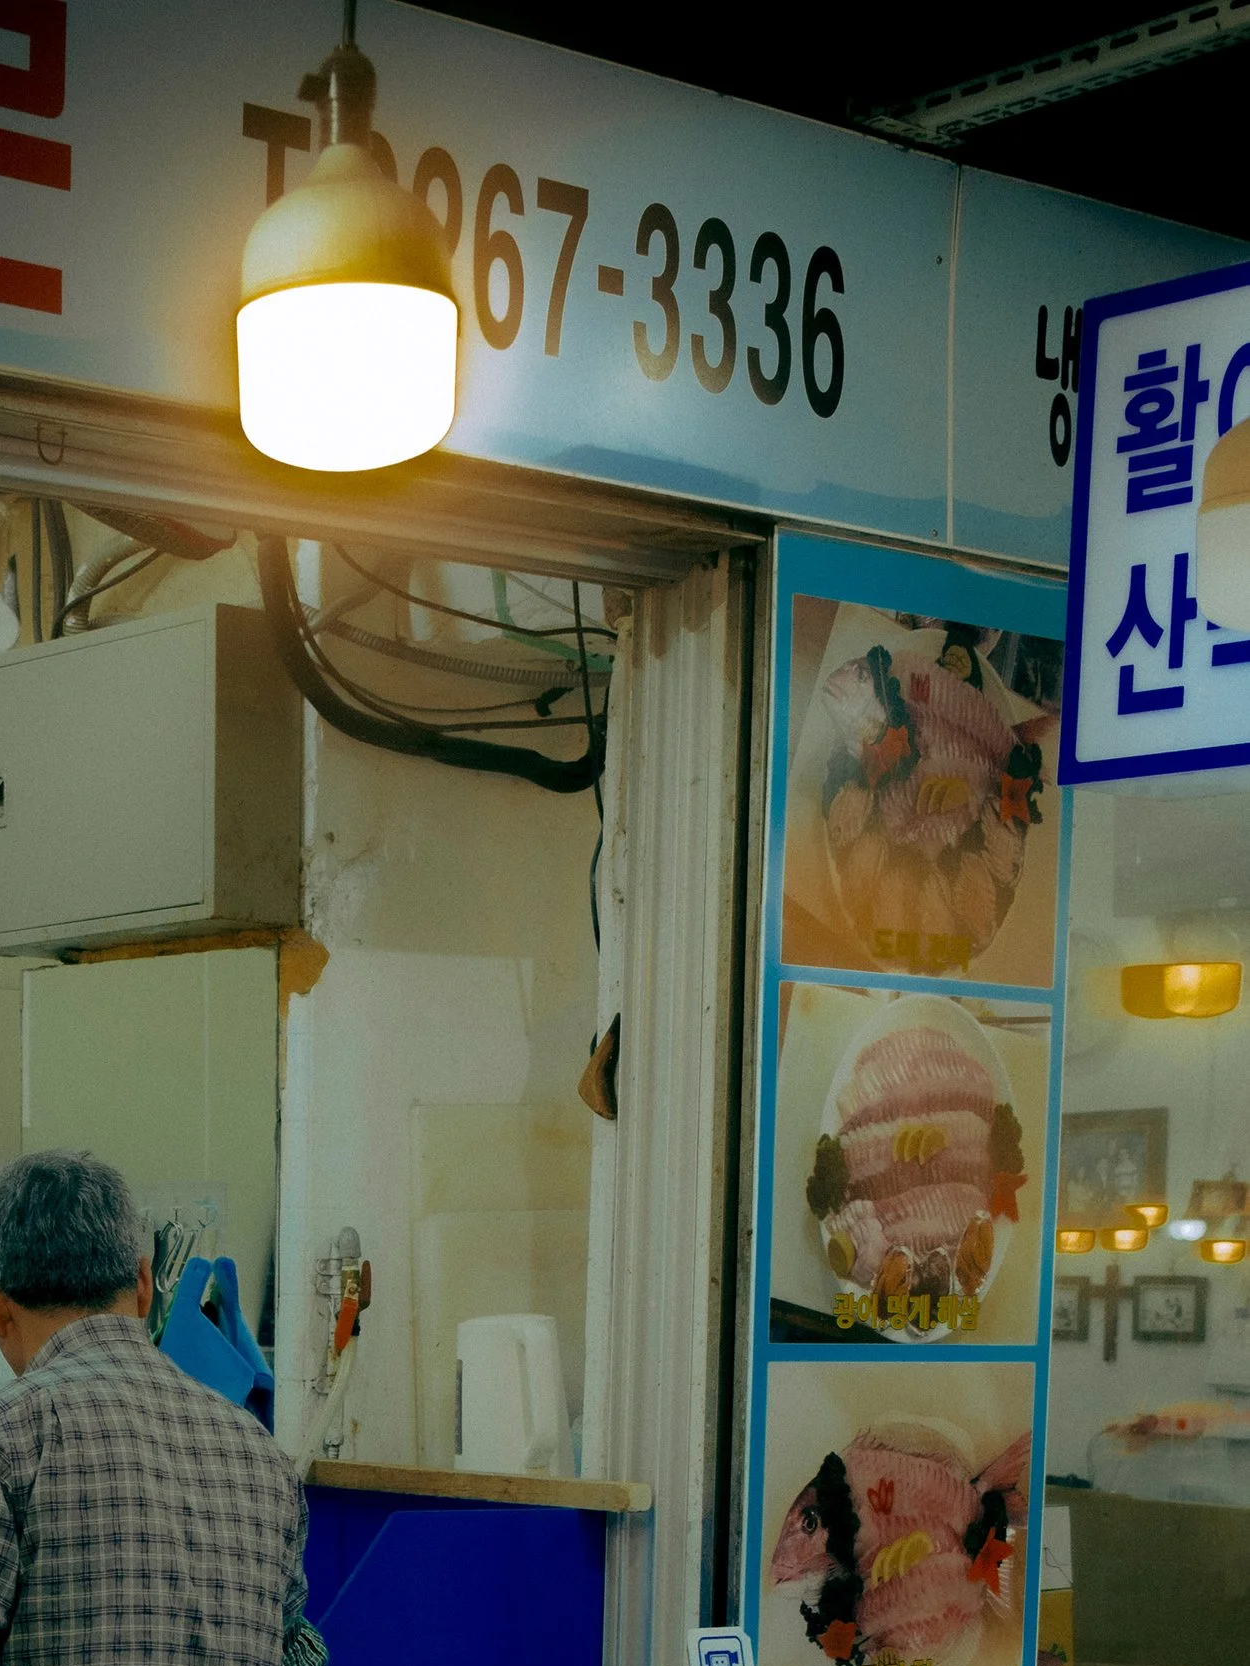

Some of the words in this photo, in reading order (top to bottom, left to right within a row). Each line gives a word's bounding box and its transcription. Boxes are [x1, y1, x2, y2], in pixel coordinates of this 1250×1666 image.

[369, 130, 846, 420] 67-3336
[1116, 341, 1250, 515] 활
[1105, 552, 1250, 717] 산
